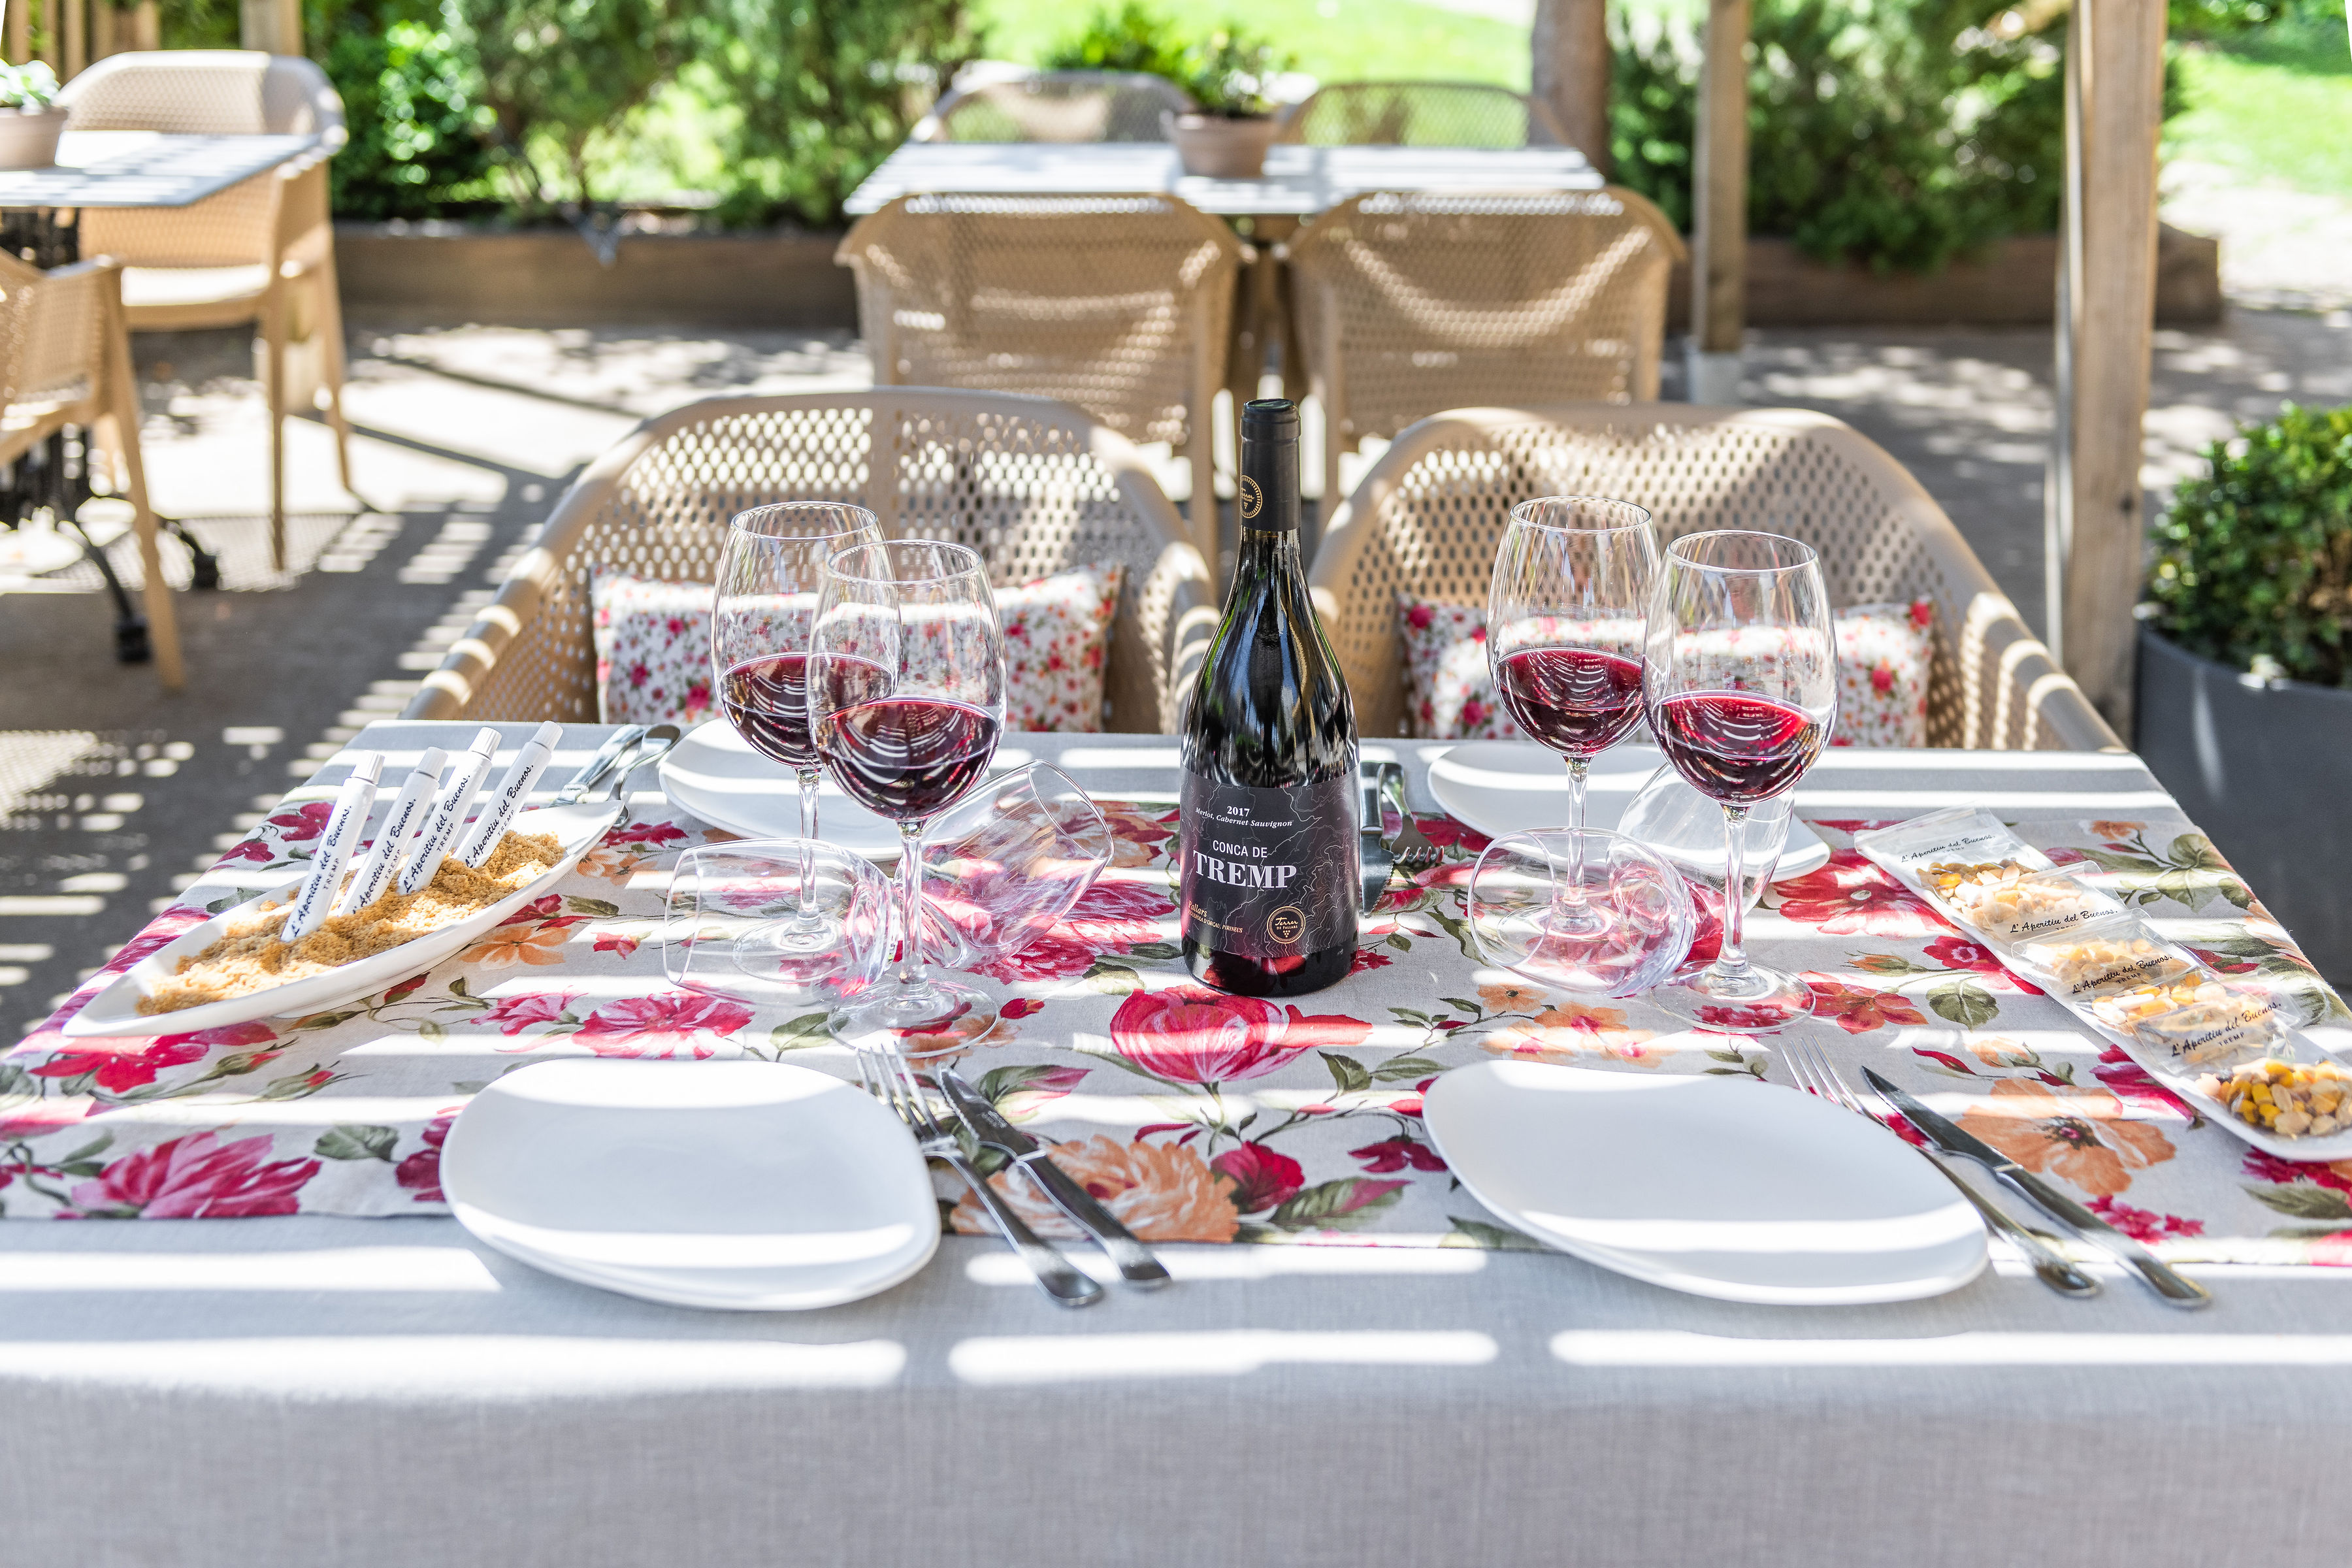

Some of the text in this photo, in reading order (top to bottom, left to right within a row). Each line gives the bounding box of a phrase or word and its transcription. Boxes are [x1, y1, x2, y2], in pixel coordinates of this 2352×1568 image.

[436, 814, 448, 832] del
[444, 774, 470, 811] Buenos.
[498, 800, 510, 817] del
[507, 765, 534, 798] Buenos.
[497, 809, 514, 836] TREMP
[1196, 807, 1292, 828] Merlot, Cabernet Sauvignon
[1227, 806, 1250, 817] 2017
[319, 851, 331, 870] del
[327, 806, 351, 847] Buenos.
[383, 841, 395, 859] del
[390, 798, 416, 838] Buenos.
[436, 823, 454, 852] TREMP
[1213, 840, 1267, 858] CONCA DE
[323, 858, 339, 889] TREMP
[385, 849, 400, 879] TREMP
[1193, 849, 1297, 889] TREMP
[1188, 900, 1207, 917] Pallars
[1275, 917, 1298, 926] Terrer
[2080, 909, 2117, 919] Buenos.
[1222, 924, 1243, 933] PIRINEUS
[2122, 964, 2136, 973] del
[2136, 955, 2172, 969] Buenos.
[2225, 1017, 2240, 1032] del
[2242, 1001, 2281, 1022] Buenos.
[2218, 1032, 2244, 1045] TREMP
